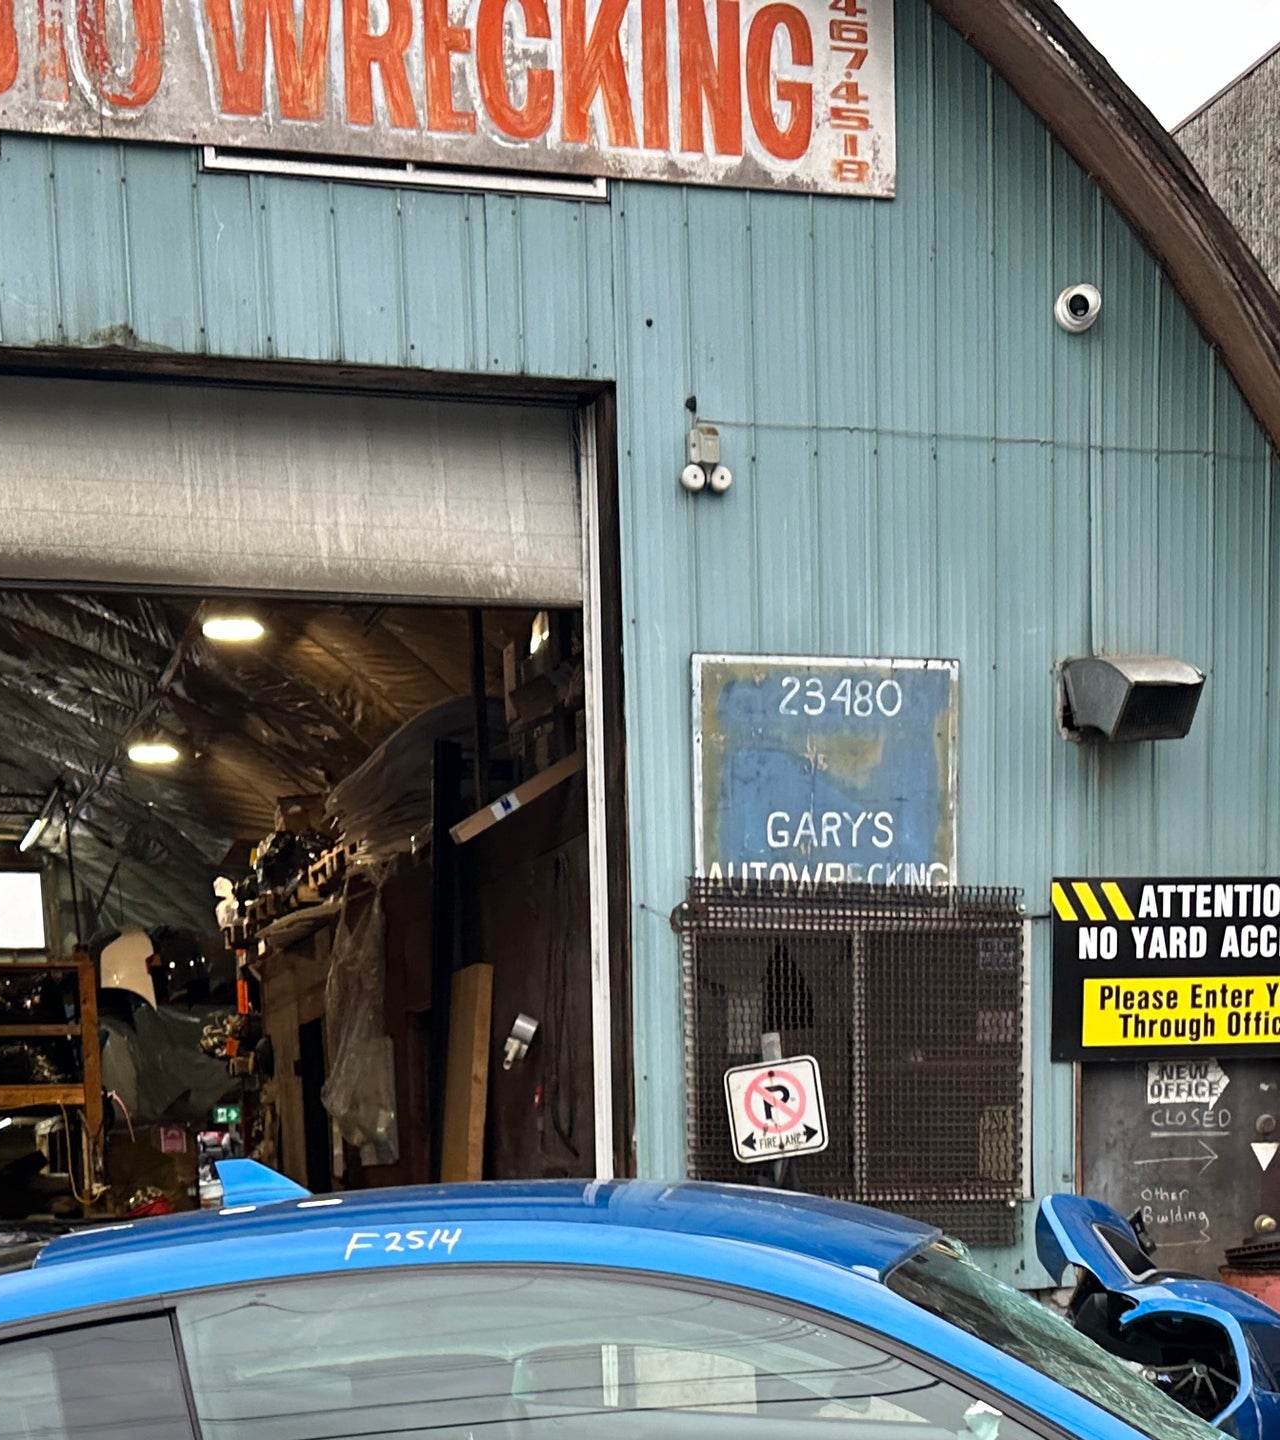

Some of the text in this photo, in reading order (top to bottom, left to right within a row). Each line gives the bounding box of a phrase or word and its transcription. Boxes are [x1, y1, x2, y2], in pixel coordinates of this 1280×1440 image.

[202, 0, 814, 161] WRECKING
[778, 676, 903, 717] 23480
[766, 811, 894, 848] GARY'S
[1078, 926, 1118, 960] NO
[1131, 925, 1208, 959] YARD
[1099, 984, 1178, 1010] Please
[1191, 983, 1255, 1009] Enter
[1118, 1012, 1215, 1041] Through
[1161, 1063, 1209, 1080] NEW
[1150, 1080, 1220, 1099] OFFICE
[1151, 1108, 1231, 1127] CLOSED
[759, 1136, 777, 1150] FIRE
[1141, 1187, 1189, 1201] Other
[1143, 1205, 1210, 1231] Building
[344, 1228, 462, 1261] F2514
